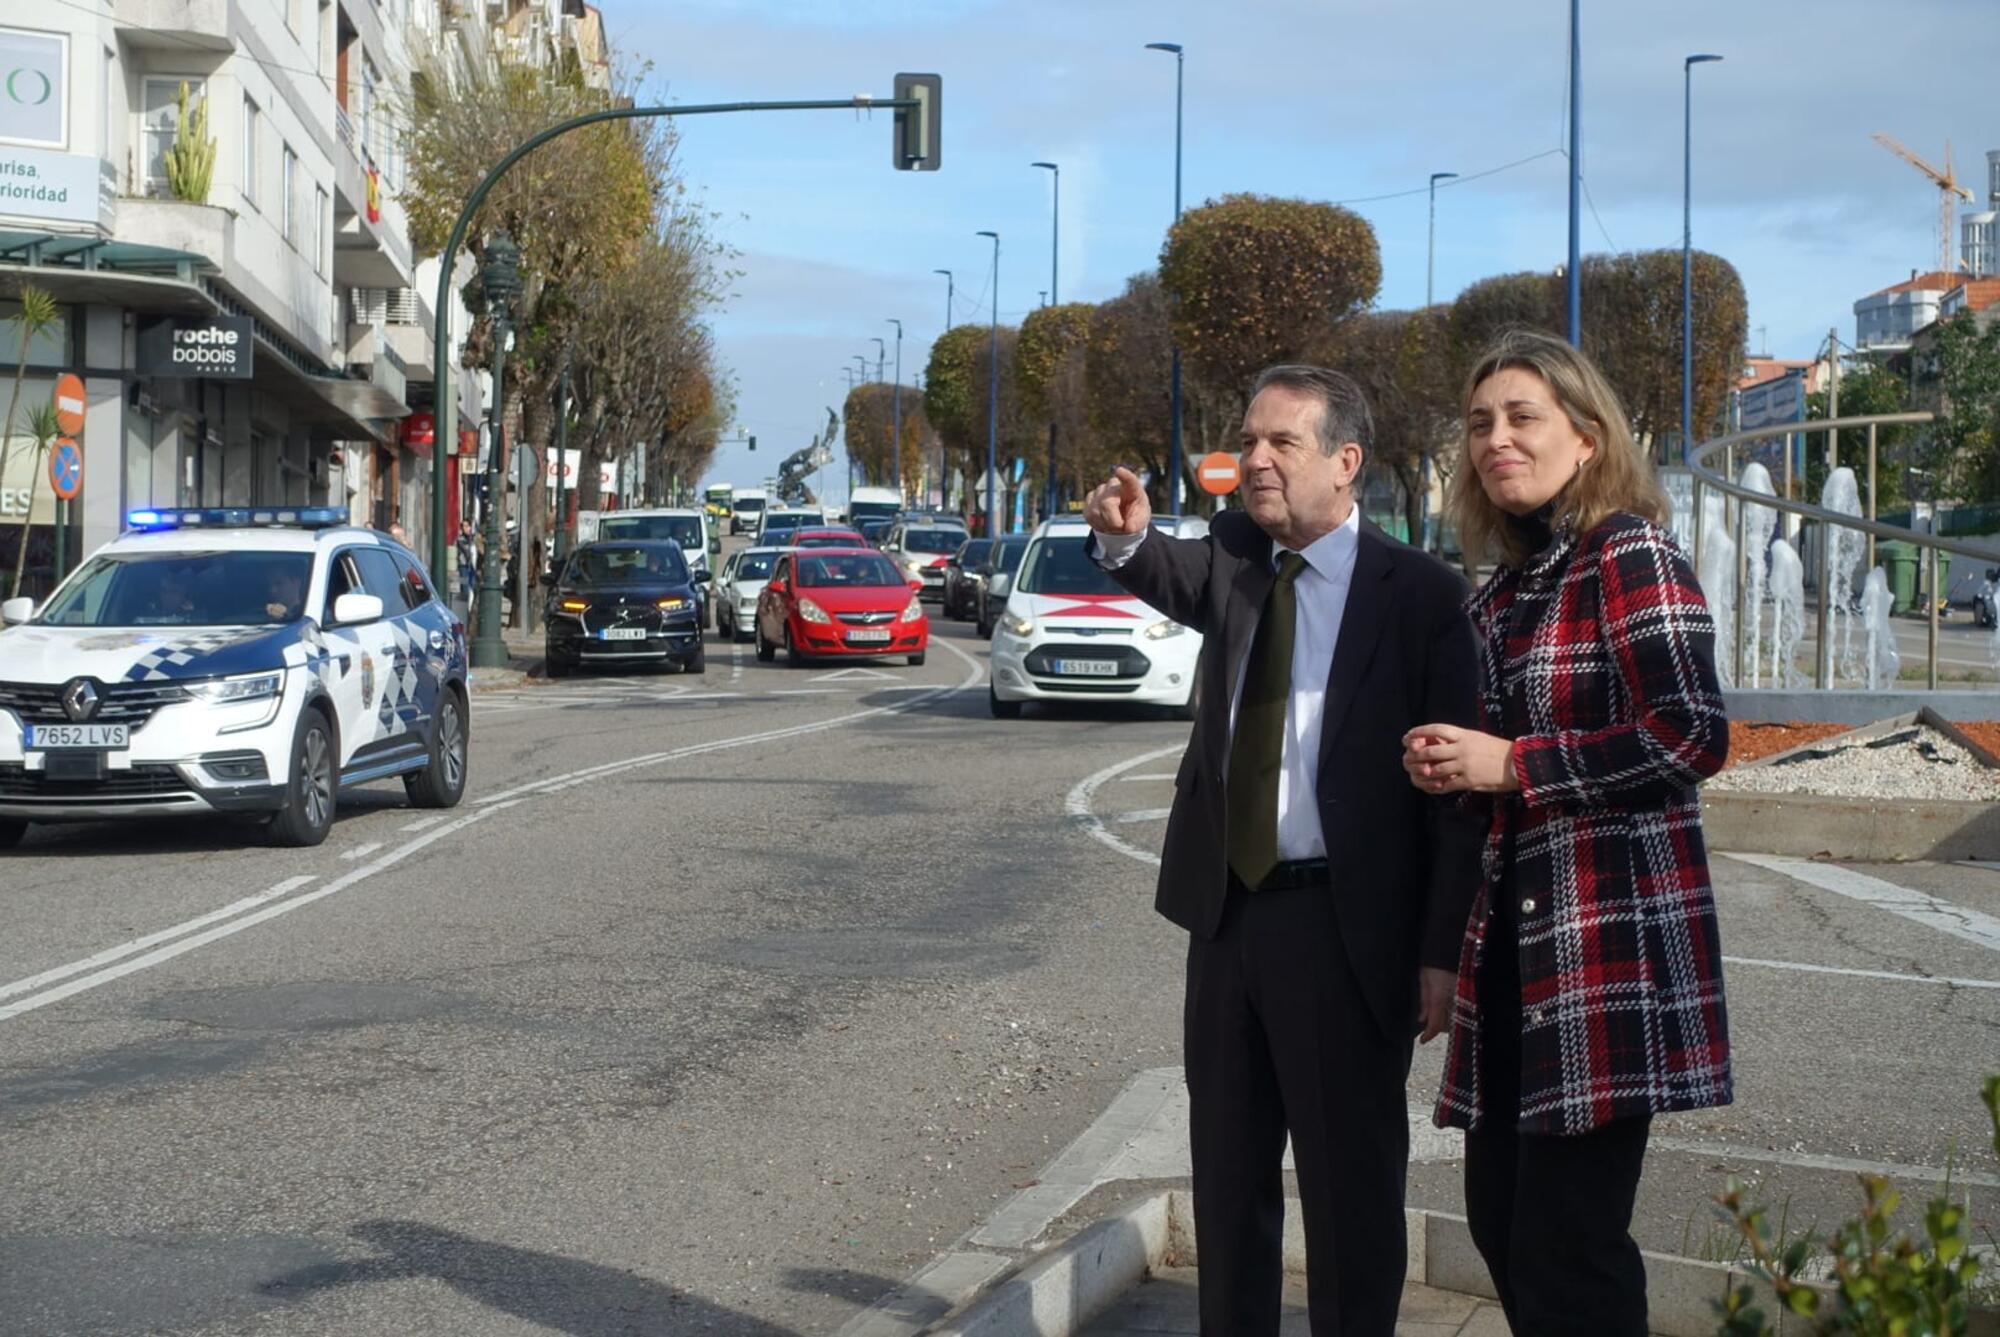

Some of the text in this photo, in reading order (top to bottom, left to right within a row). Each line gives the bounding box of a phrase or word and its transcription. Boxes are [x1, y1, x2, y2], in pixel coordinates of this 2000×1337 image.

[173, 326, 238, 344] roche
[172, 344, 236, 364] bobois
[1063, 661, 1090, 673] 6519
[37, 727, 124, 745] 7652 LVS
